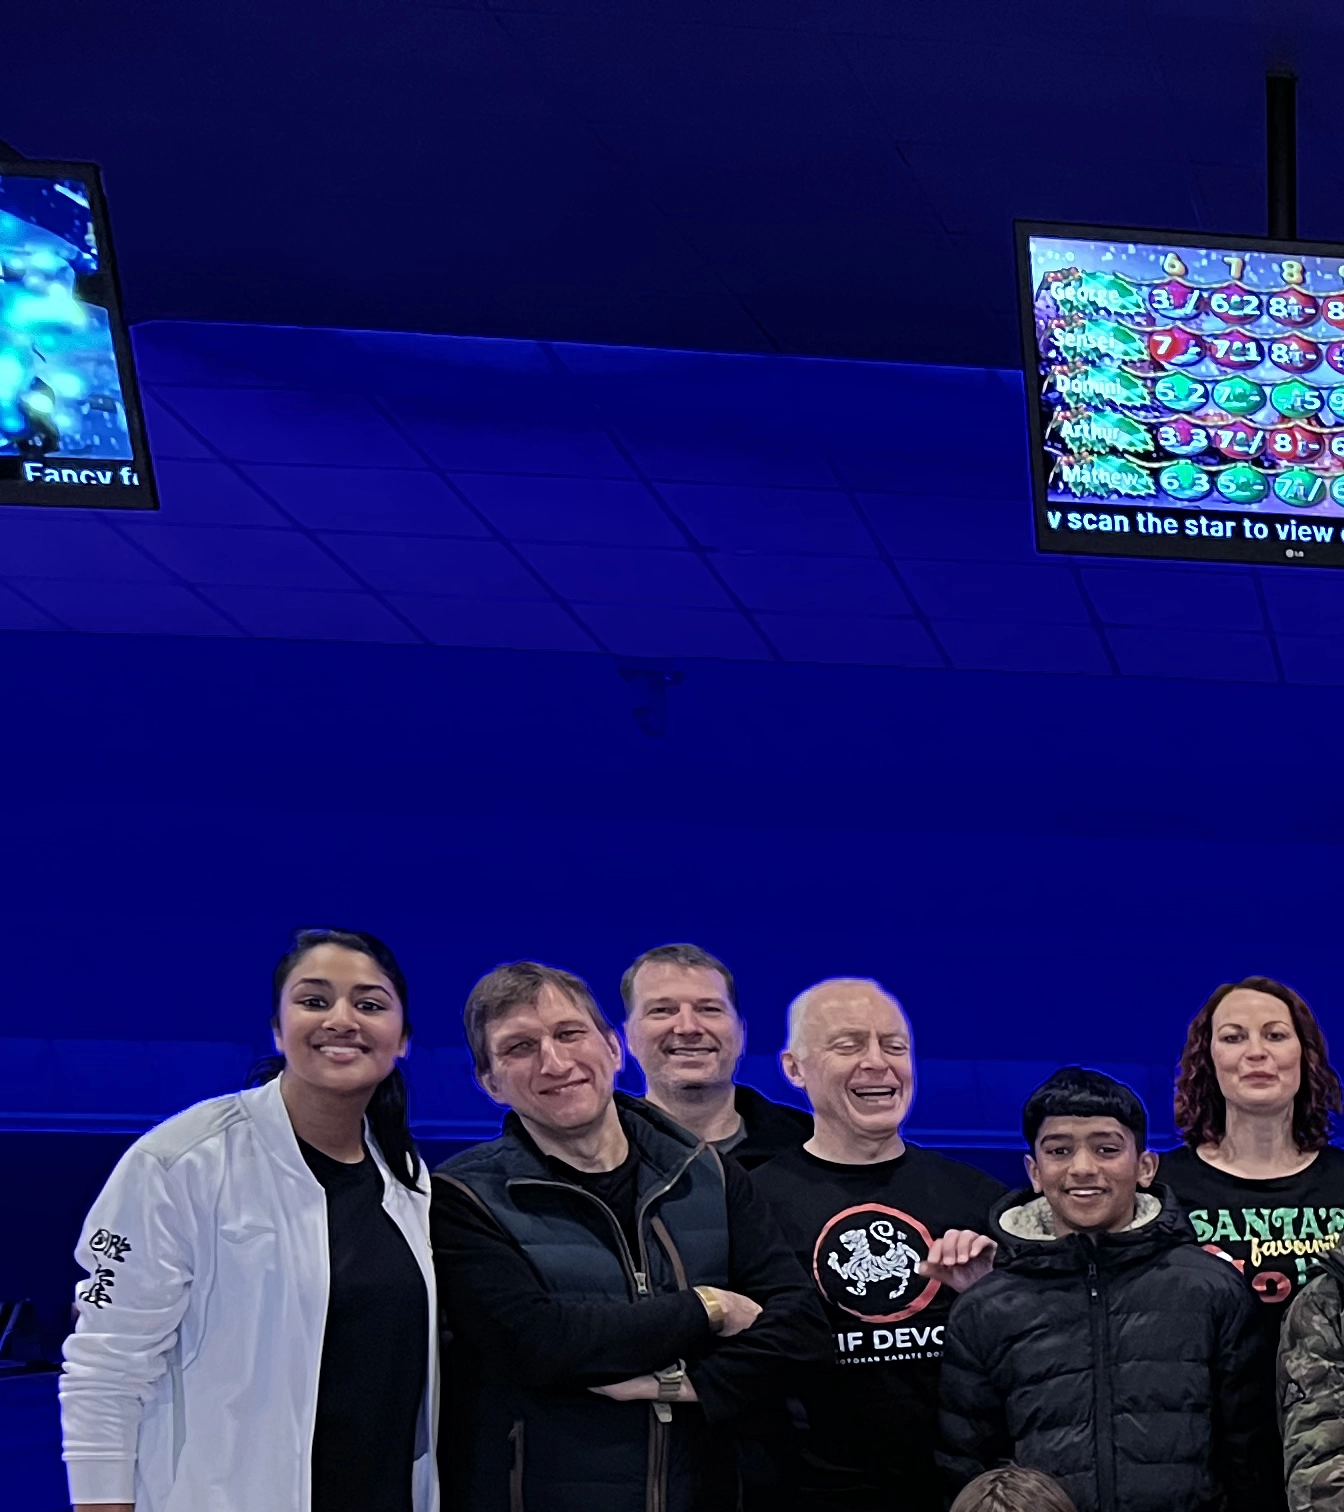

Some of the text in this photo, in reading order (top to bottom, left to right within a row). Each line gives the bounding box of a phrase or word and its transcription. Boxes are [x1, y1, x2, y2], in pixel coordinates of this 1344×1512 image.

[1163, 253, 1186, 276] 6
[1281, 261, 1303, 284] 8
[1051, 282, 1119, 307] George
[1052, 329, 1115, 348] Sensei
[1062, 466, 1139, 485] Mathew
[1068, 513, 1129, 532] scan
[1137, 512, 1178, 534] the
[1185, 516, 1236, 538] star
[1243, 518, 1268, 540] to
[1277, 520, 1333, 543] view
[837, 1325, 946, 1352] IF DEVO
